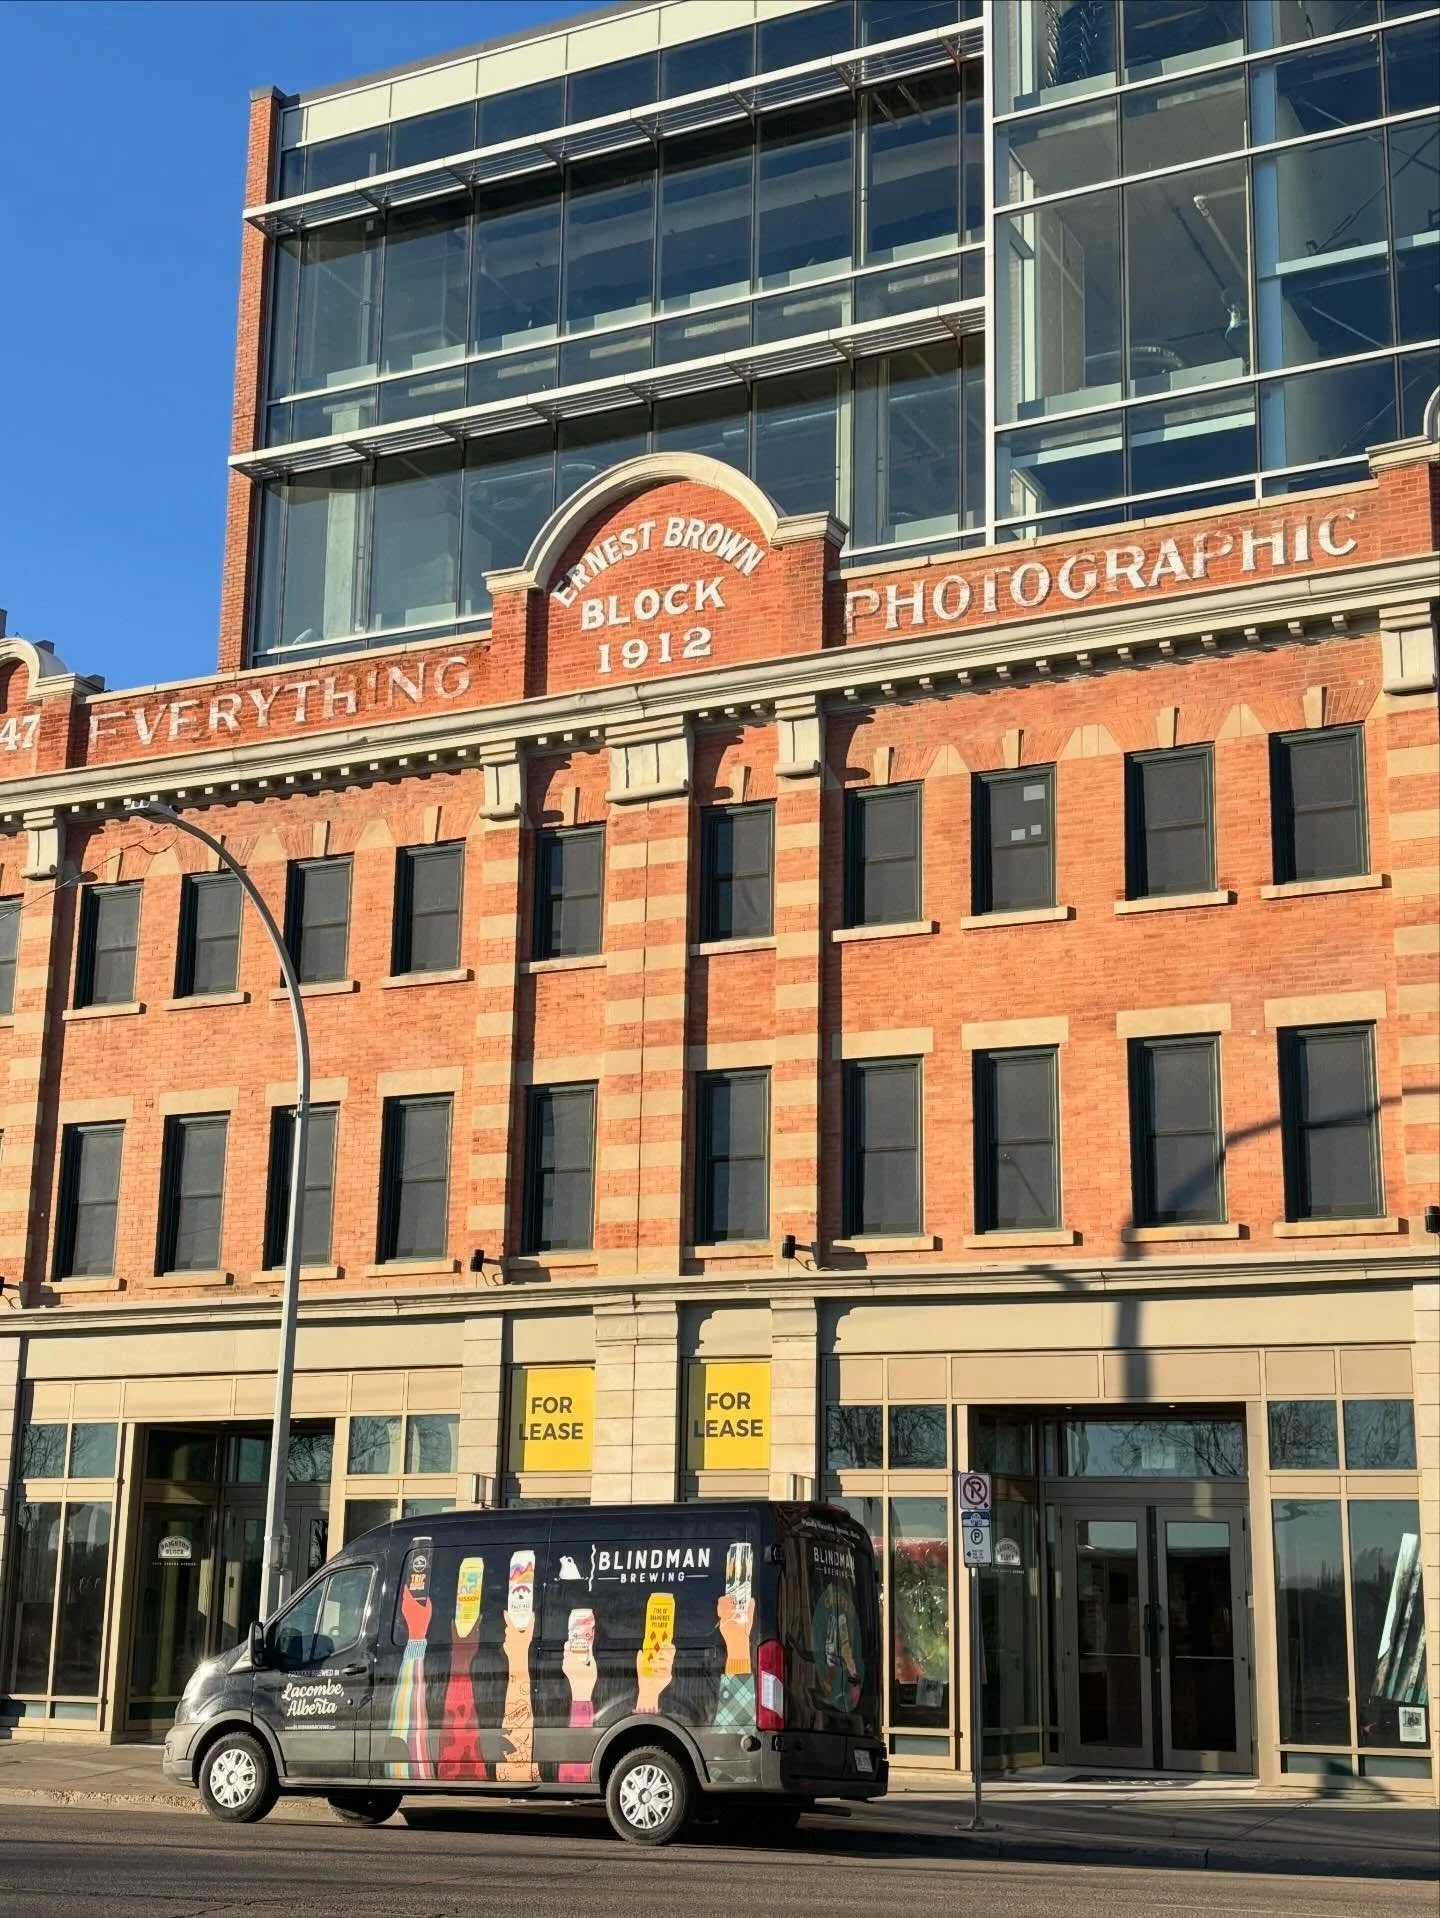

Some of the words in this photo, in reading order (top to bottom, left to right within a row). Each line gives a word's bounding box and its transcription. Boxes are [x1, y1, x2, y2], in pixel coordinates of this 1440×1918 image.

[551, 519, 656, 608] ERNEST
[663, 516, 766, 576] BROWN
[843, 507, 1358, 635] PHOTOGRAPHIC
[581, 576, 726, 631] BLOCK
[598, 626, 712, 673] 1912
[531, 1396, 573, 1415] FOR
[706, 1392, 751, 1411] FOR
[518, 1423, 584, 1441] LEASE
[693, 1419, 763, 1438] LEASE
[598, 1548, 711, 1571] BLINDMAN
[620, 1571, 685, 1584] BREWING
[281, 1678, 345, 1701] Lacombe,
[286, 1697, 338, 1717] Alberta
